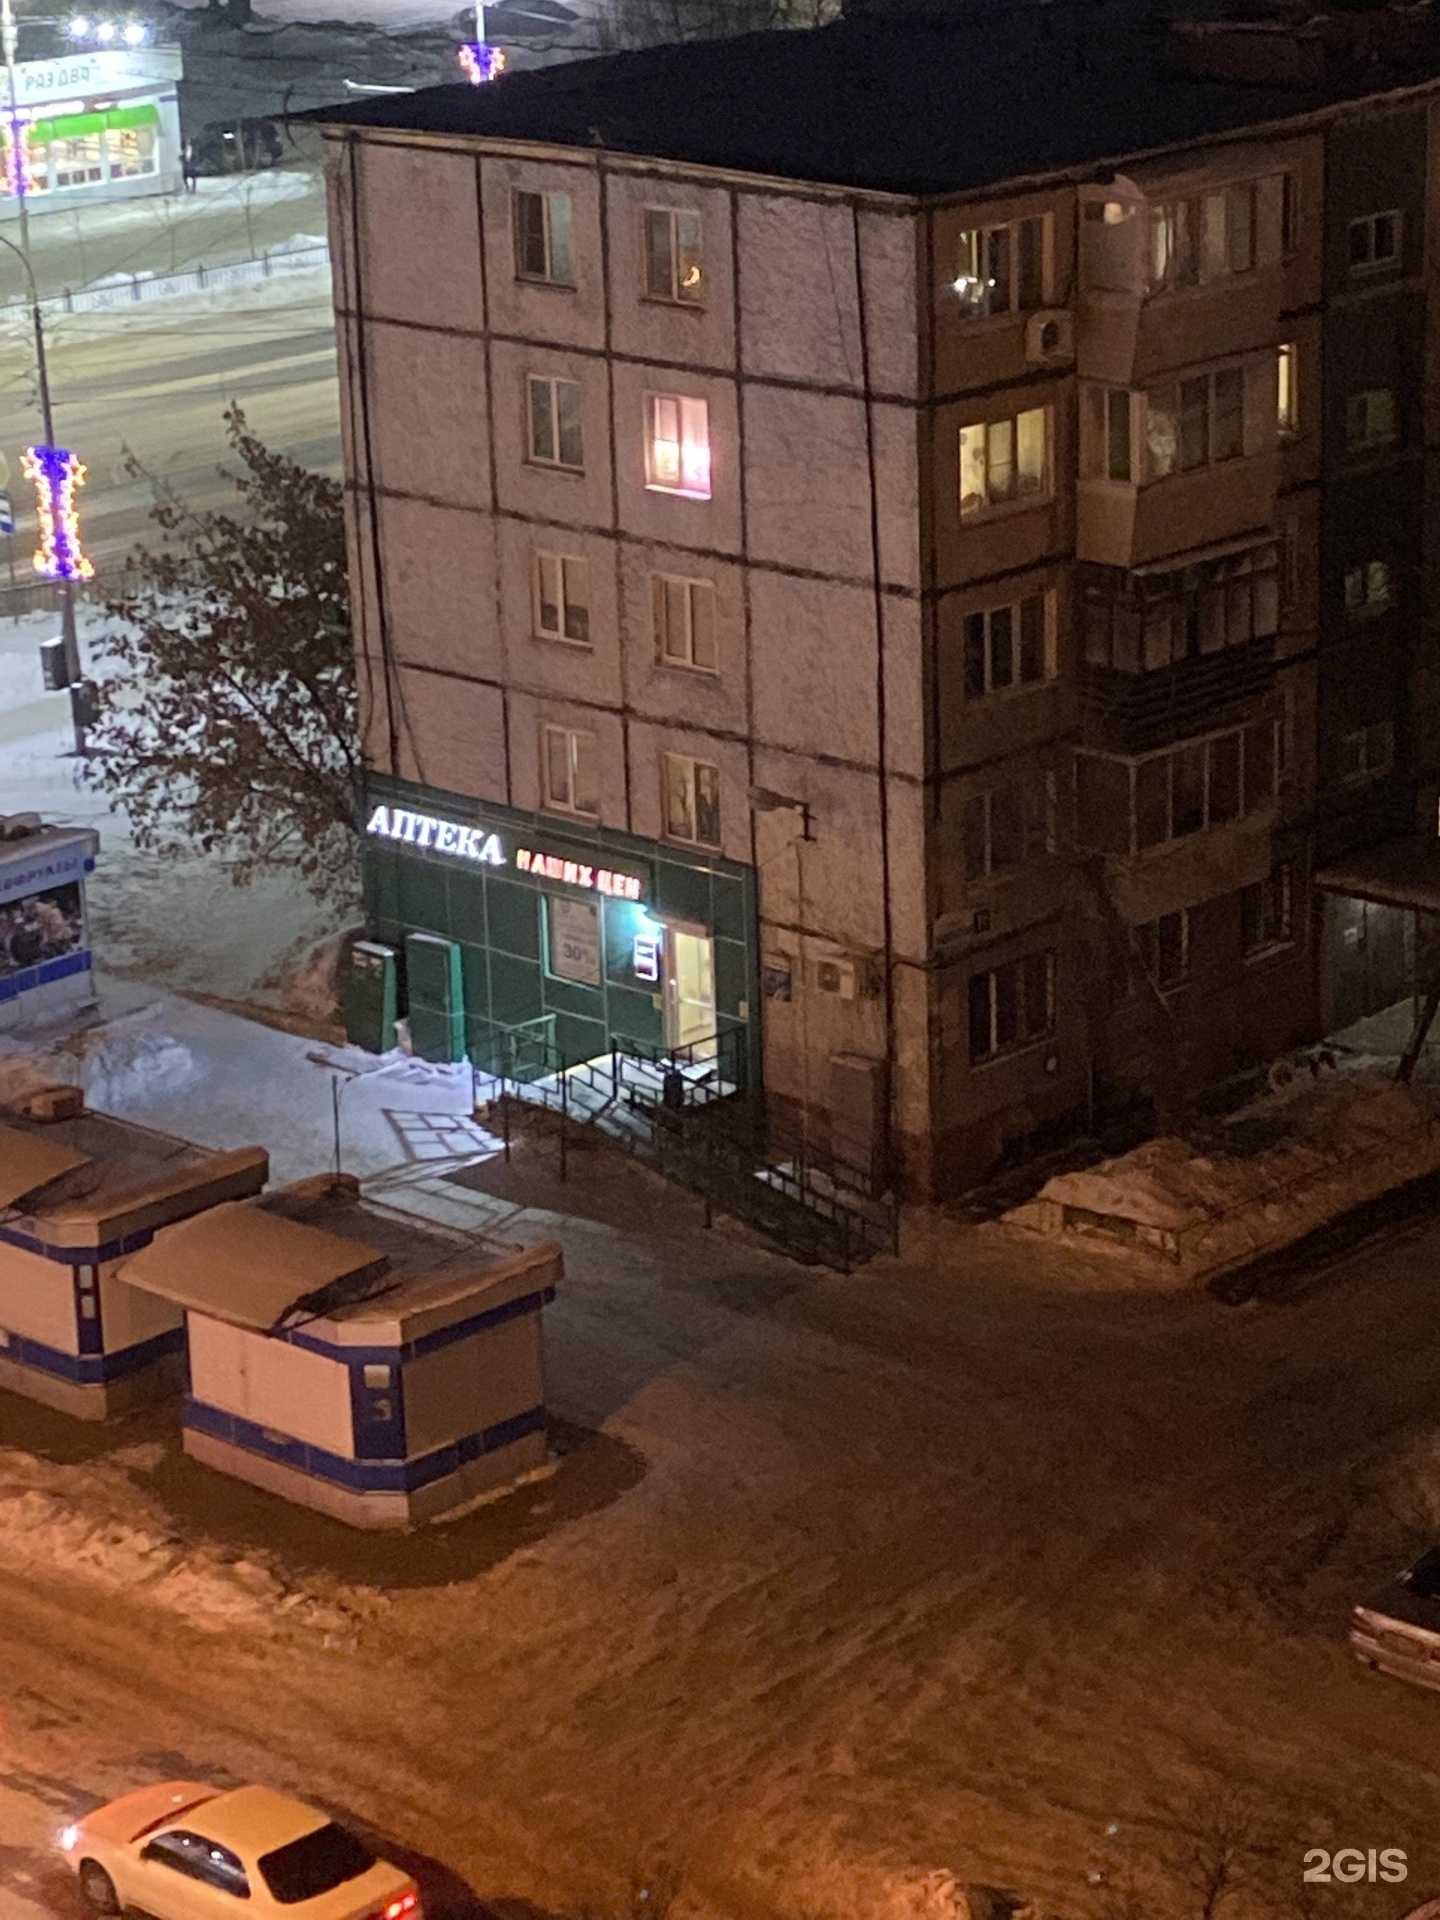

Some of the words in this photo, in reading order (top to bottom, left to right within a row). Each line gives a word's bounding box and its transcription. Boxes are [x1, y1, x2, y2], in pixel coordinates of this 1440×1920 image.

[367, 805, 507, 865] АПТЕКА
[517, 849, 593, 888] НАШИХ
[597, 868, 640, 900] ЦЕН
